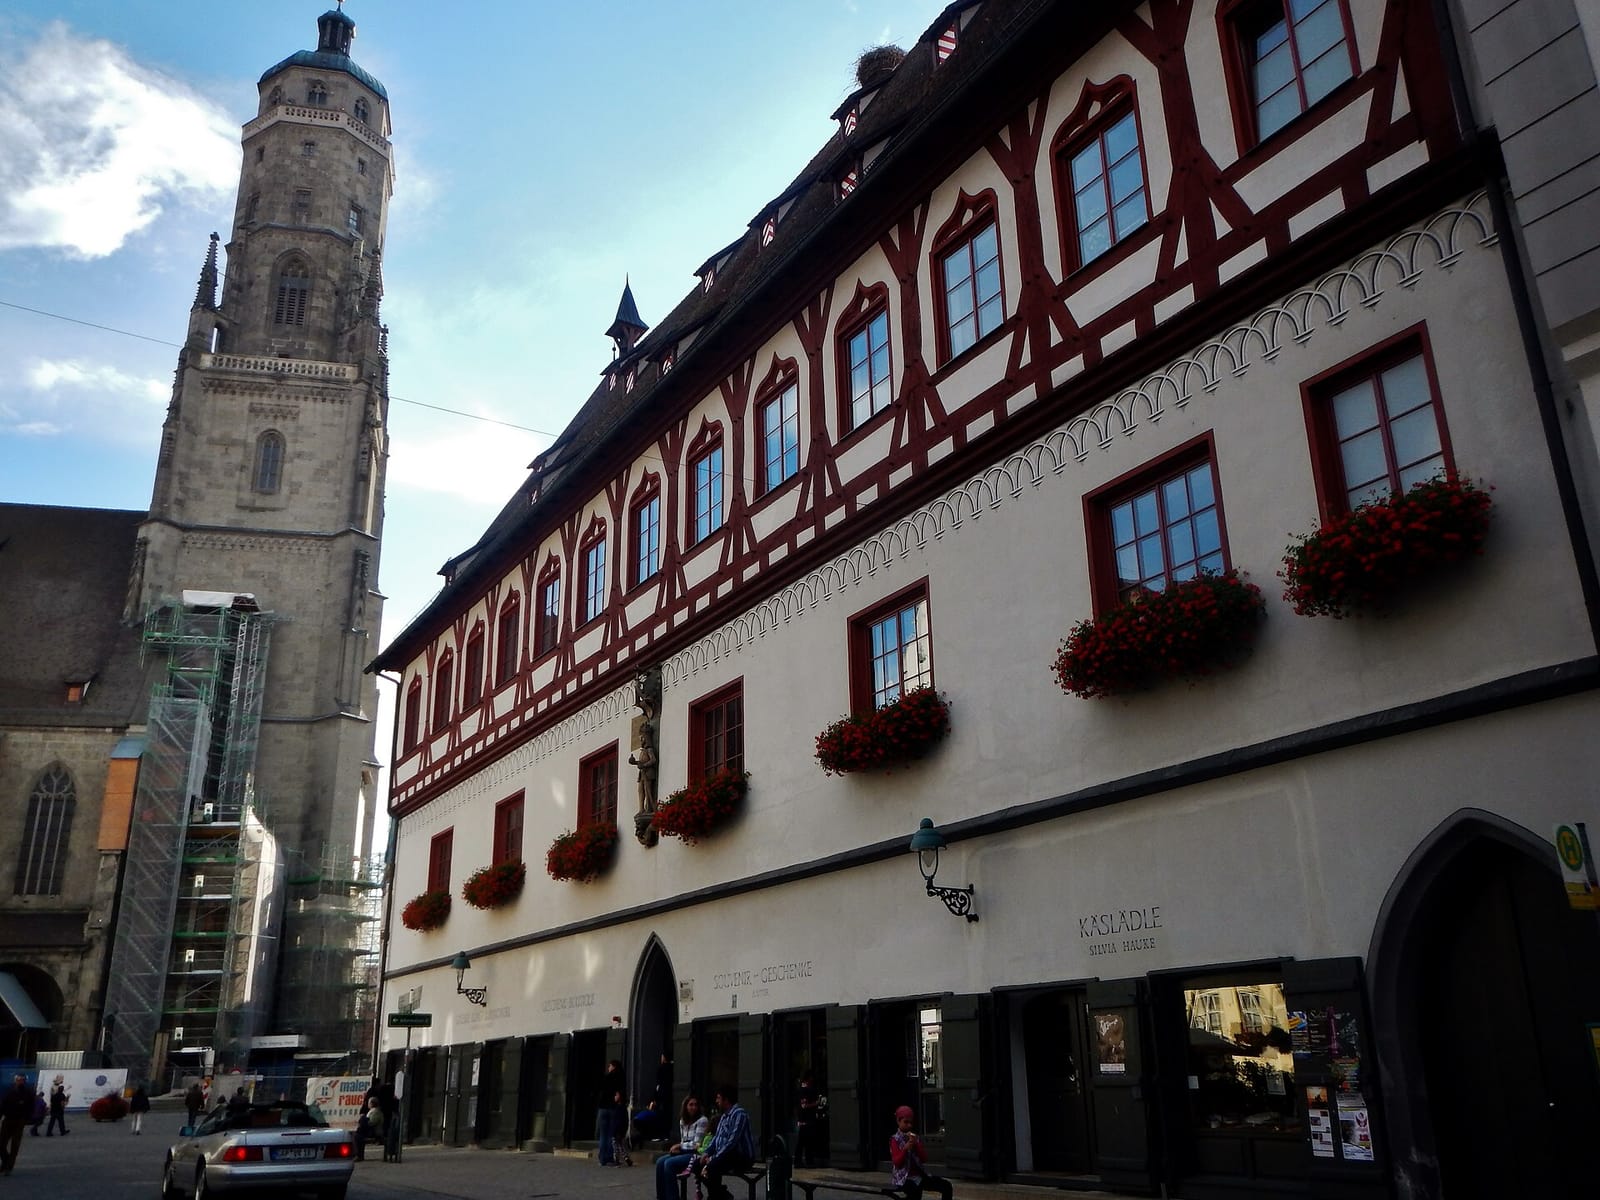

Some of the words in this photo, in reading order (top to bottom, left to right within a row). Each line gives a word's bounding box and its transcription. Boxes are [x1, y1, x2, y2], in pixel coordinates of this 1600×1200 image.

[1079, 907, 1162, 938] KÄSLÄDLE
[1089, 942, 1117, 956] SILVIA
[1123, 938, 1156, 952] HAUKE
[713, 970, 752, 990] SOUVENIR
[761, 961, 812, 983] GESCHENKE
[340, 1080, 370, 1092] maler
